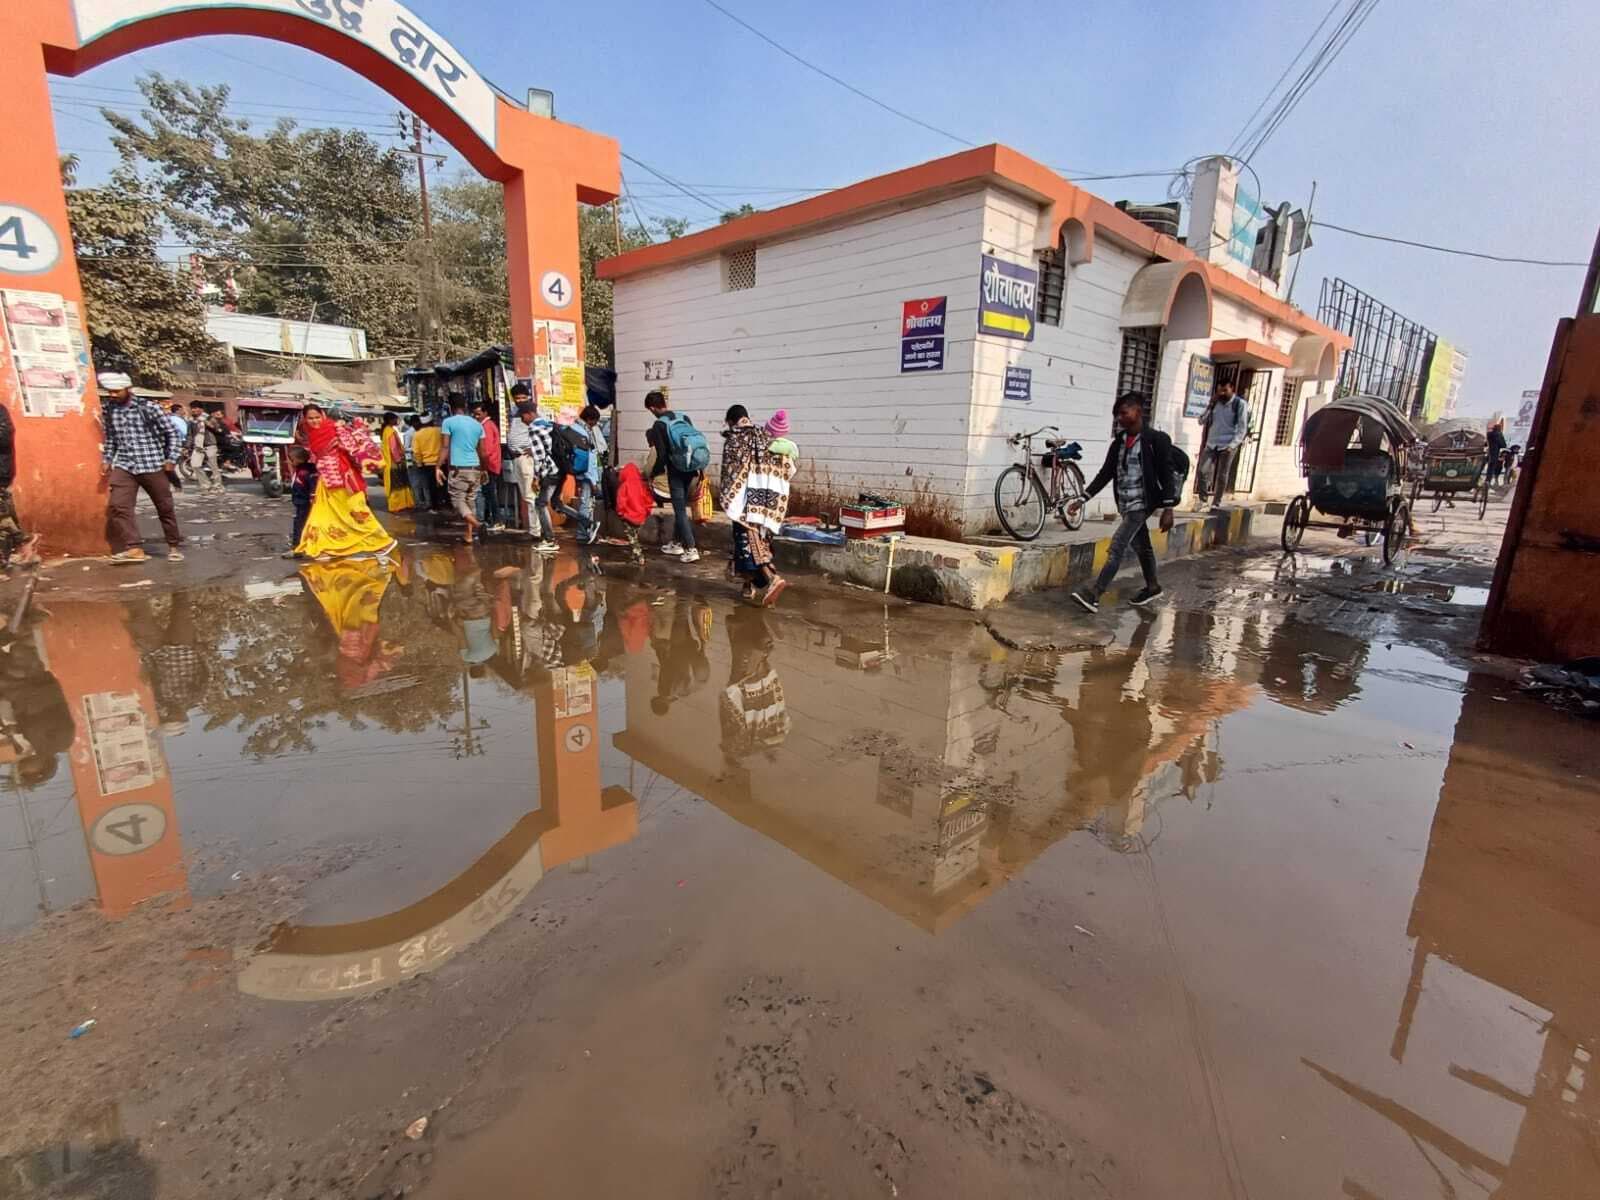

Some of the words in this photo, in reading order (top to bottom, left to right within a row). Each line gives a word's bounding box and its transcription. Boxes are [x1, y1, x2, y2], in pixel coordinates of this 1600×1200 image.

[390, 16, 468, 98] द्वार
[0, 216, 37, 259] 4
[548, 278, 564, 302] 4
[983, 262, 1035, 310] शौचालय
